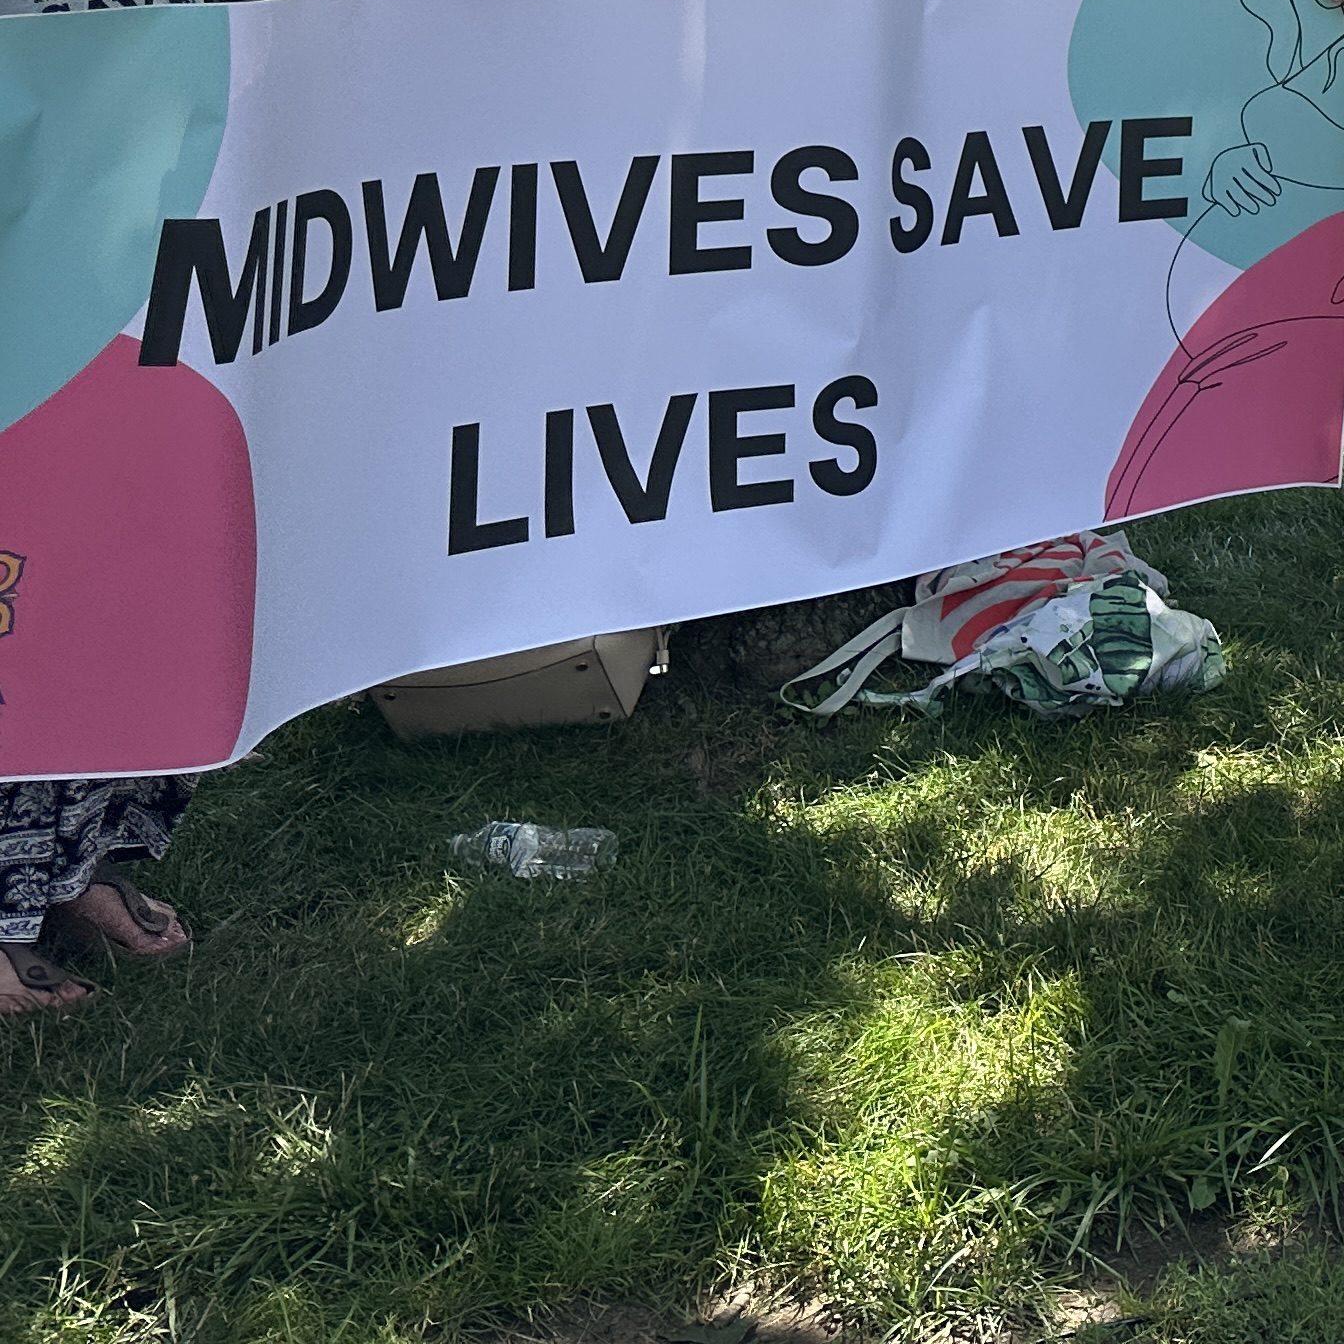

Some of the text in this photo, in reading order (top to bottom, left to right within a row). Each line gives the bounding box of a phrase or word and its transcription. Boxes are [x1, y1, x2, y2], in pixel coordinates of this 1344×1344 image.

[136, 115, 1193, 367] MIDWIVES SAVE
[447, 374, 881, 557] LIVES
